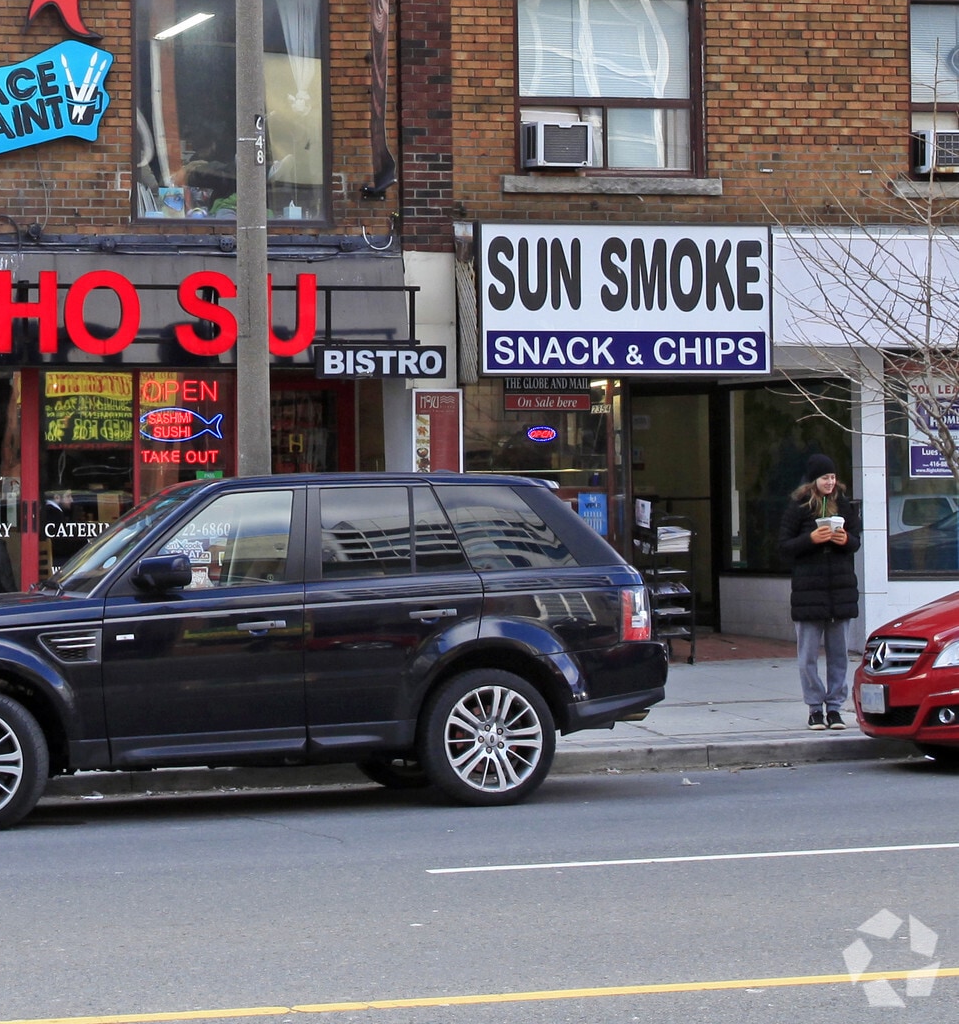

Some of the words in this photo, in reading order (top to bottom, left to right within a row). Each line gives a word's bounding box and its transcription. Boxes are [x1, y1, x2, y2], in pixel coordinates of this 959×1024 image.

[488, 236, 581, 311] SUN
[600, 236, 764, 312] SMOKE
[494, 336, 615, 366] SNACK
[626, 344, 643, 366] &
[653, 337, 758, 366] CHIPS
[324, 350, 442, 375] BISTRO
[505, 377, 521, 389] THE
[523, 377, 549, 389] GLOBE
[550, 377, 568, 389] AND
[569, 377, 590, 390] MAIL
[143, 380, 217, 402] OPEN
[517, 396, 533, 408] On
[534, 396, 555, 408] Sale
[556, 396, 578, 408] here
[148, 412, 192, 424] SASHIMI
[153, 426, 191, 438] SUSHI
[141, 450, 180, 463] TAKE
[186, 450, 219, 463] OUT
[44, 522, 110, 538] CATERI
